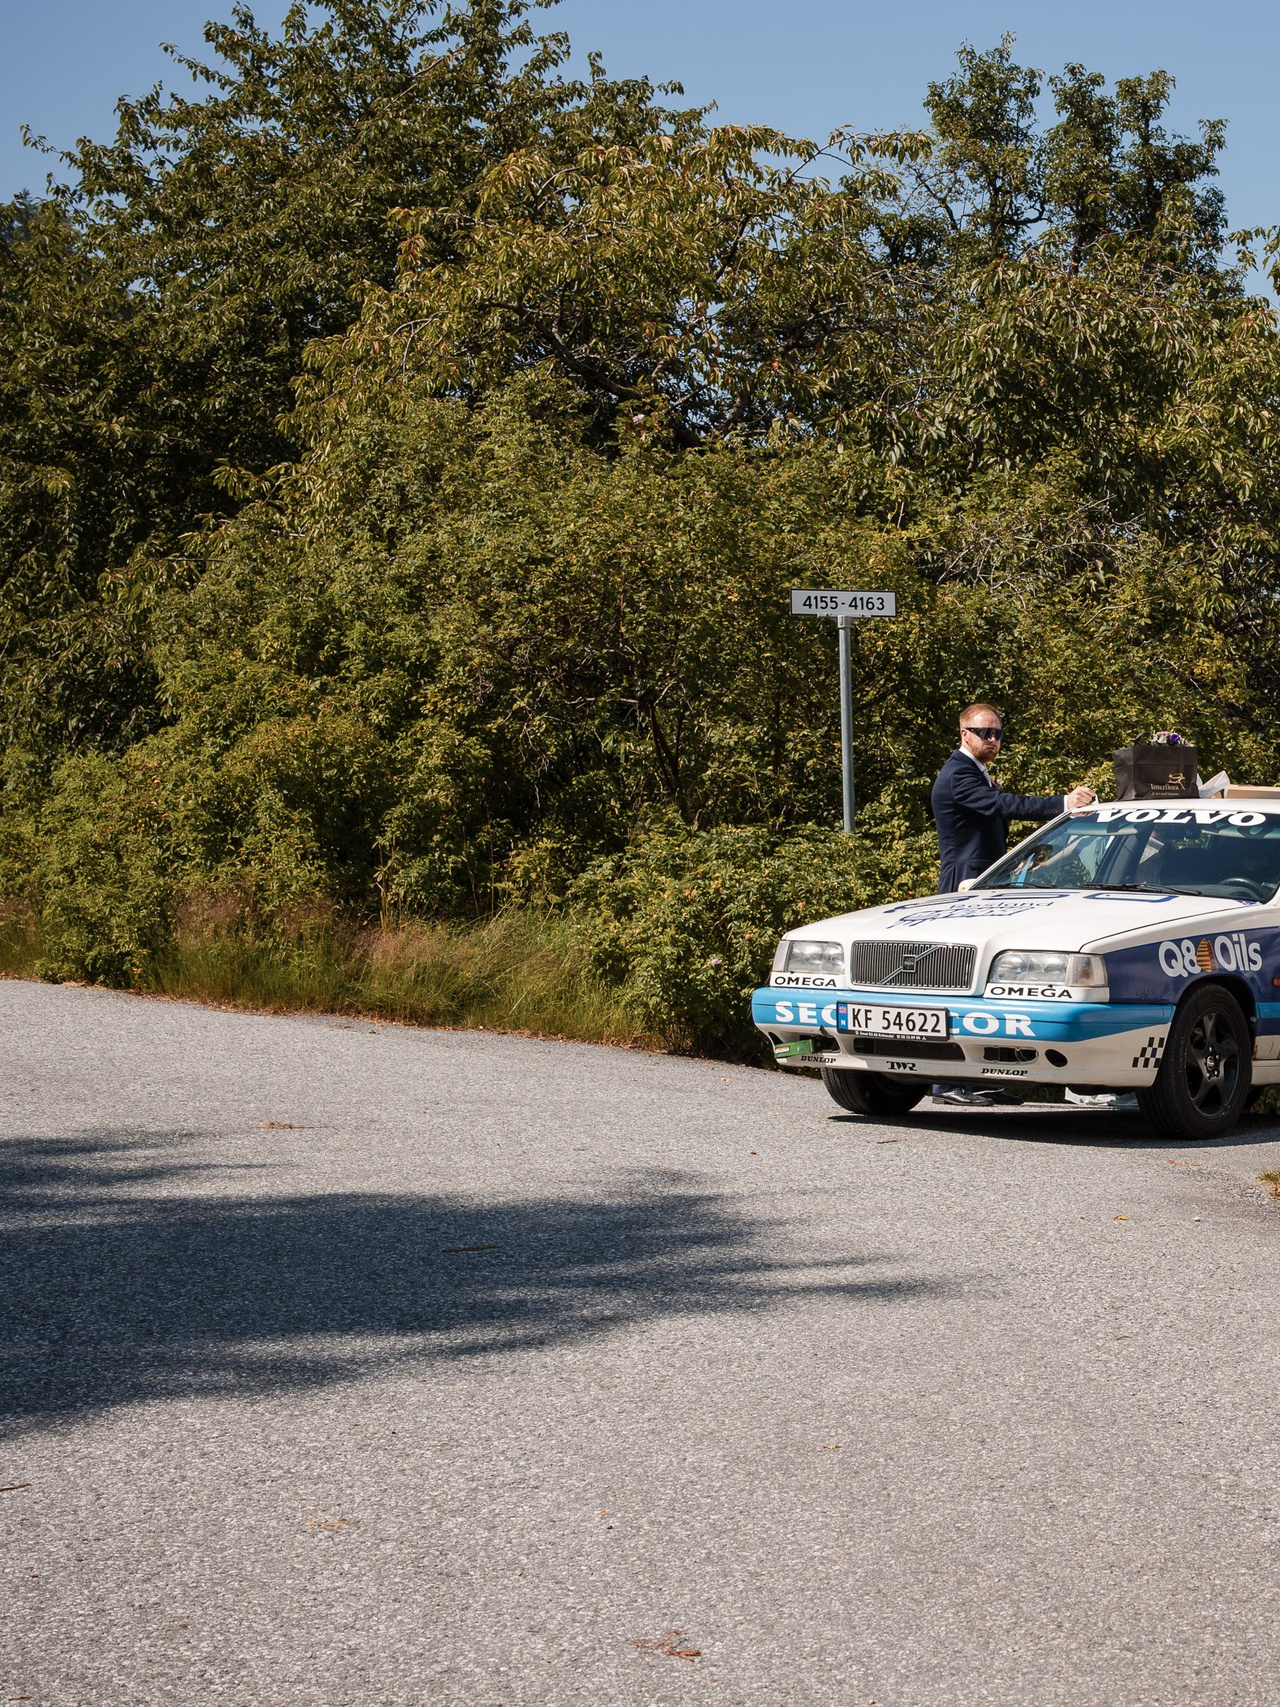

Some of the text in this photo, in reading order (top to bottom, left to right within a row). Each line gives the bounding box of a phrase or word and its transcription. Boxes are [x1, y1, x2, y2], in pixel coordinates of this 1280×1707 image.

[1096, 809, 1267, 827] VOLVO
[1158, 933, 1263, 978] Q8 Oils
[774, 976, 837, 988] OMEGA
[990, 986, 1073, 999] OMEGA
[852, 1008, 942, 1034] KF 54622
[801, 1055, 837, 1064] DUNLOP
[981, 1067, 1028, 1077] DUNLOP
